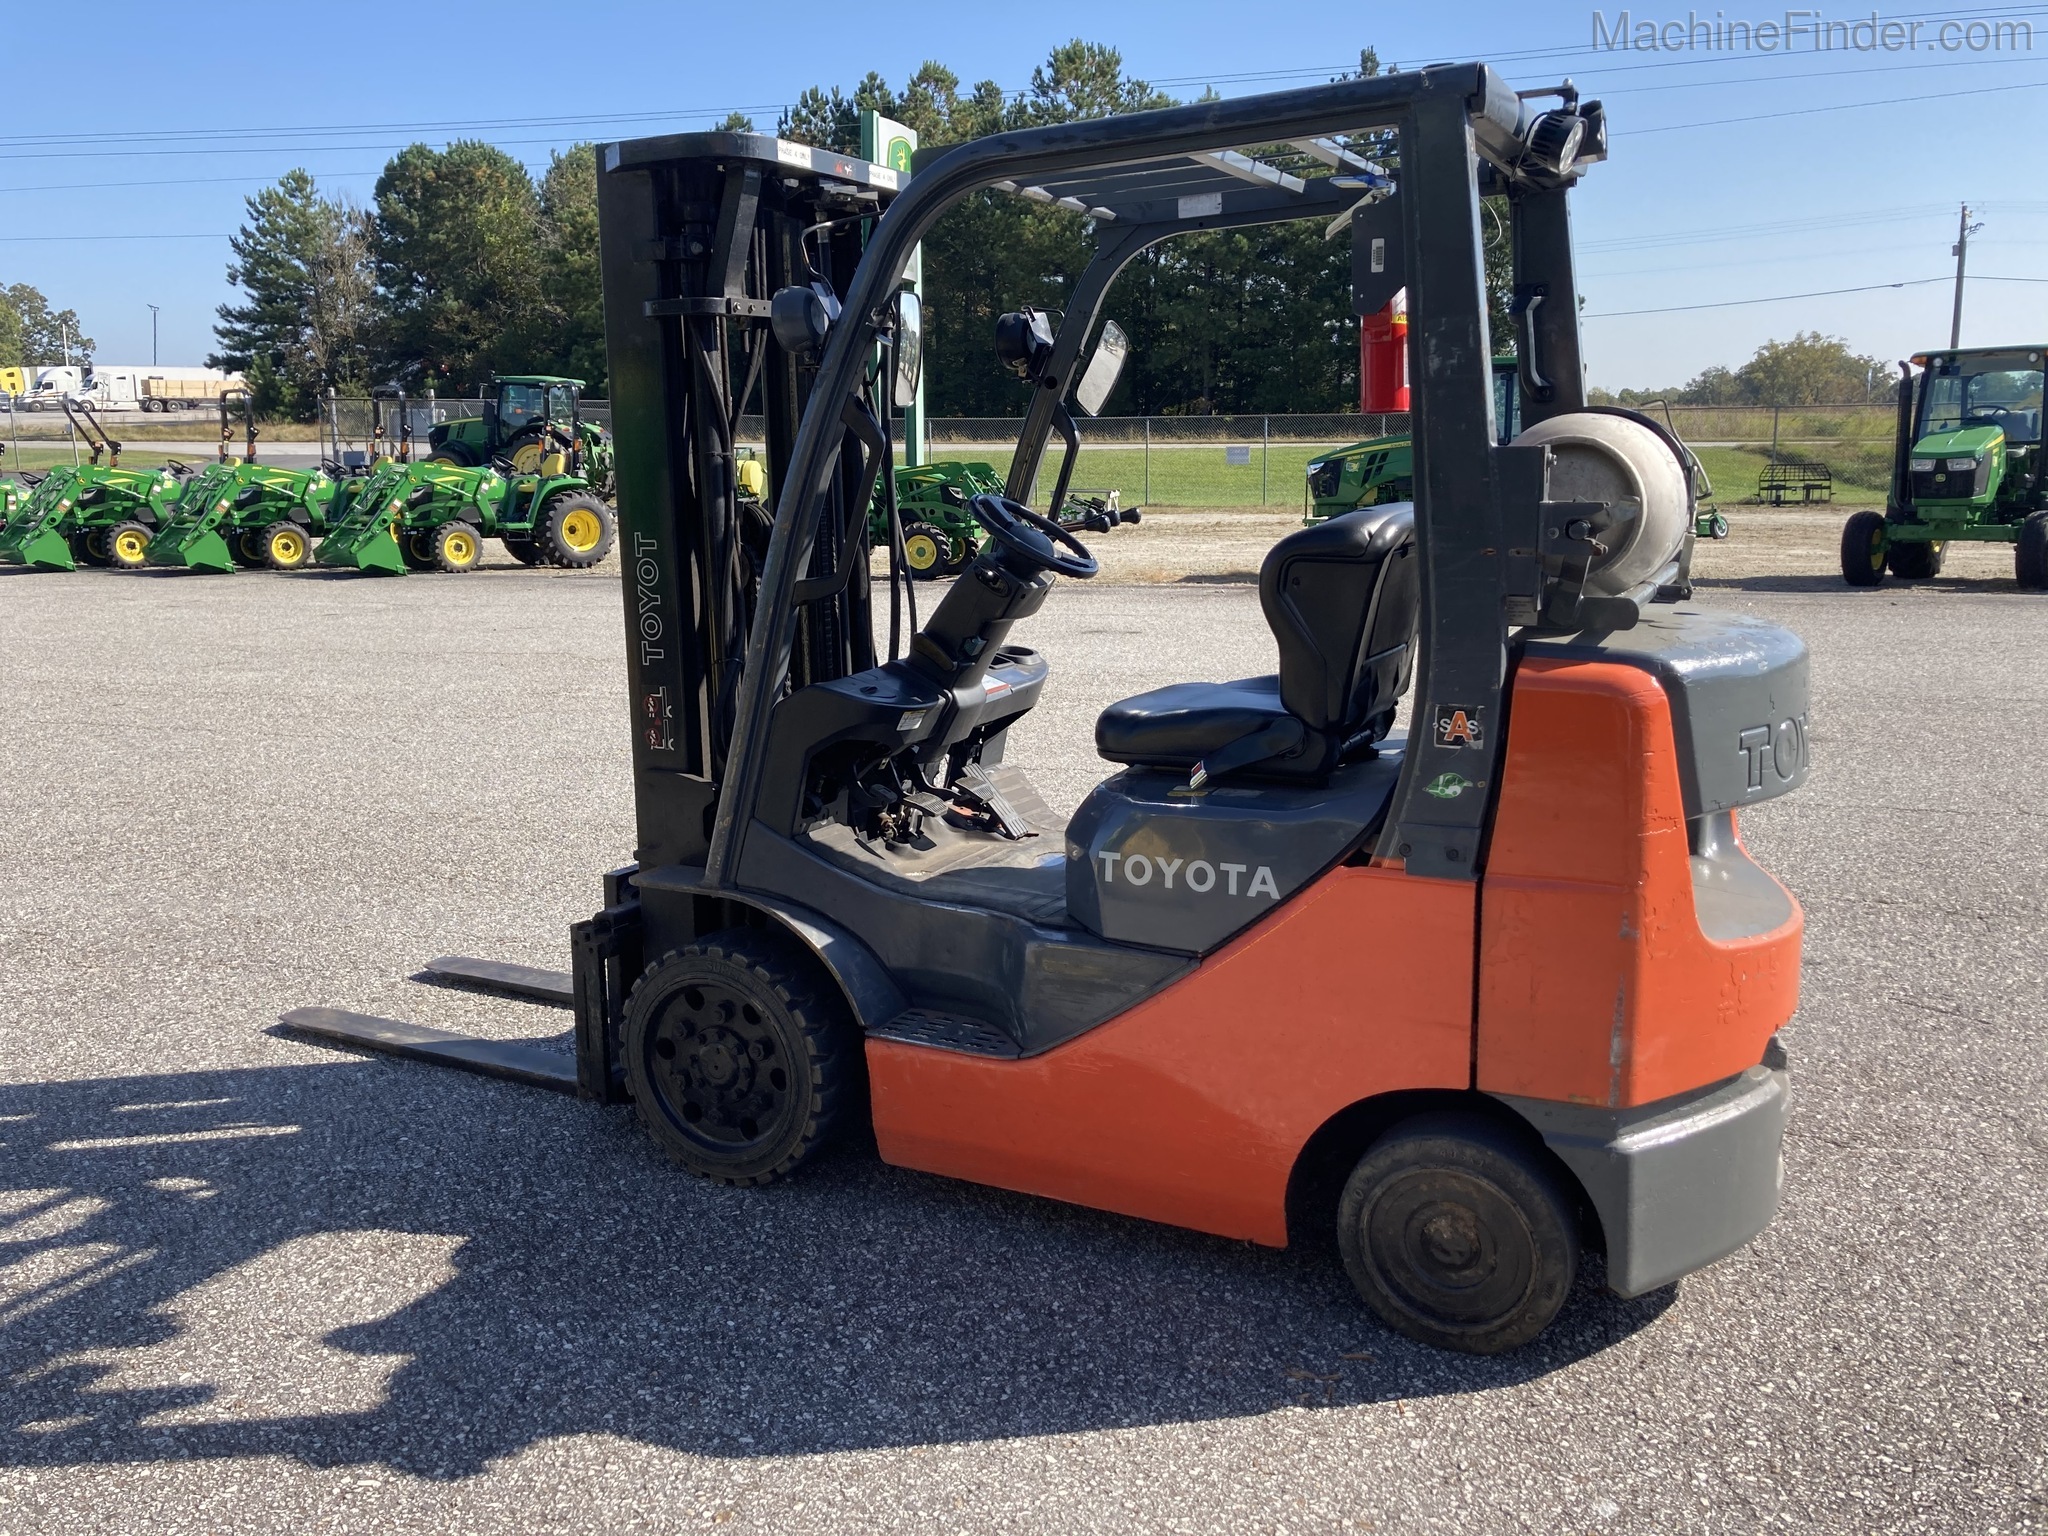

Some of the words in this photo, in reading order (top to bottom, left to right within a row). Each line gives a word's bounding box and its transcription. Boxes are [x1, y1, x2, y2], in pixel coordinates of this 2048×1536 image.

[634, 531, 664, 667] TOYOT
[1439, 710, 1479, 742] SAS
[1098, 850, 1281, 900] TOYOTA
